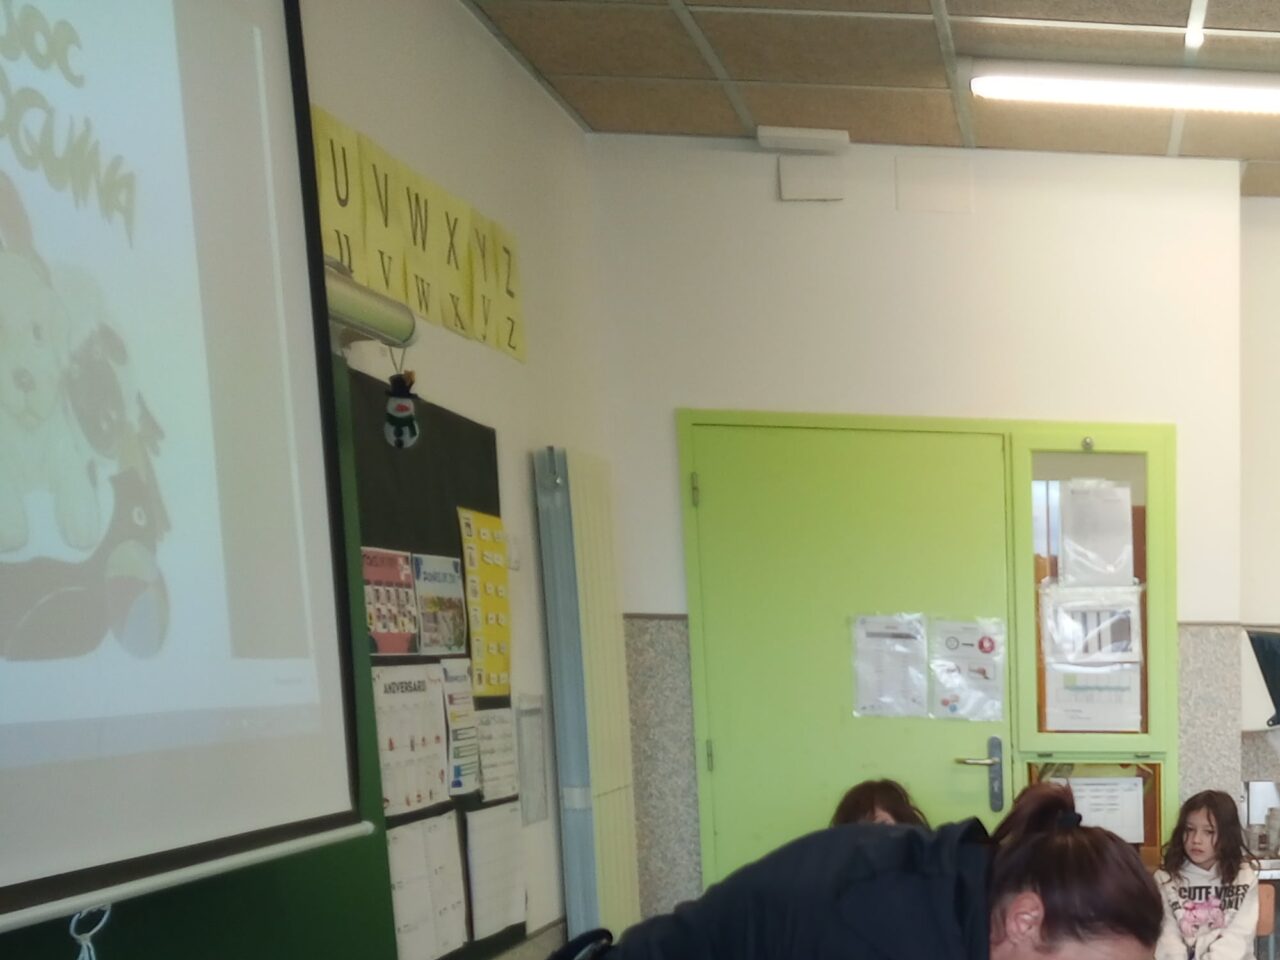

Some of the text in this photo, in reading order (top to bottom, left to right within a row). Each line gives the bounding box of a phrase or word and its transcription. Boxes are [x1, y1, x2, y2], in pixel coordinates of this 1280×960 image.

[330, 138, 515, 299] U V W X Y Z
[1178, 884, 1250, 901] CUTE VIBES
